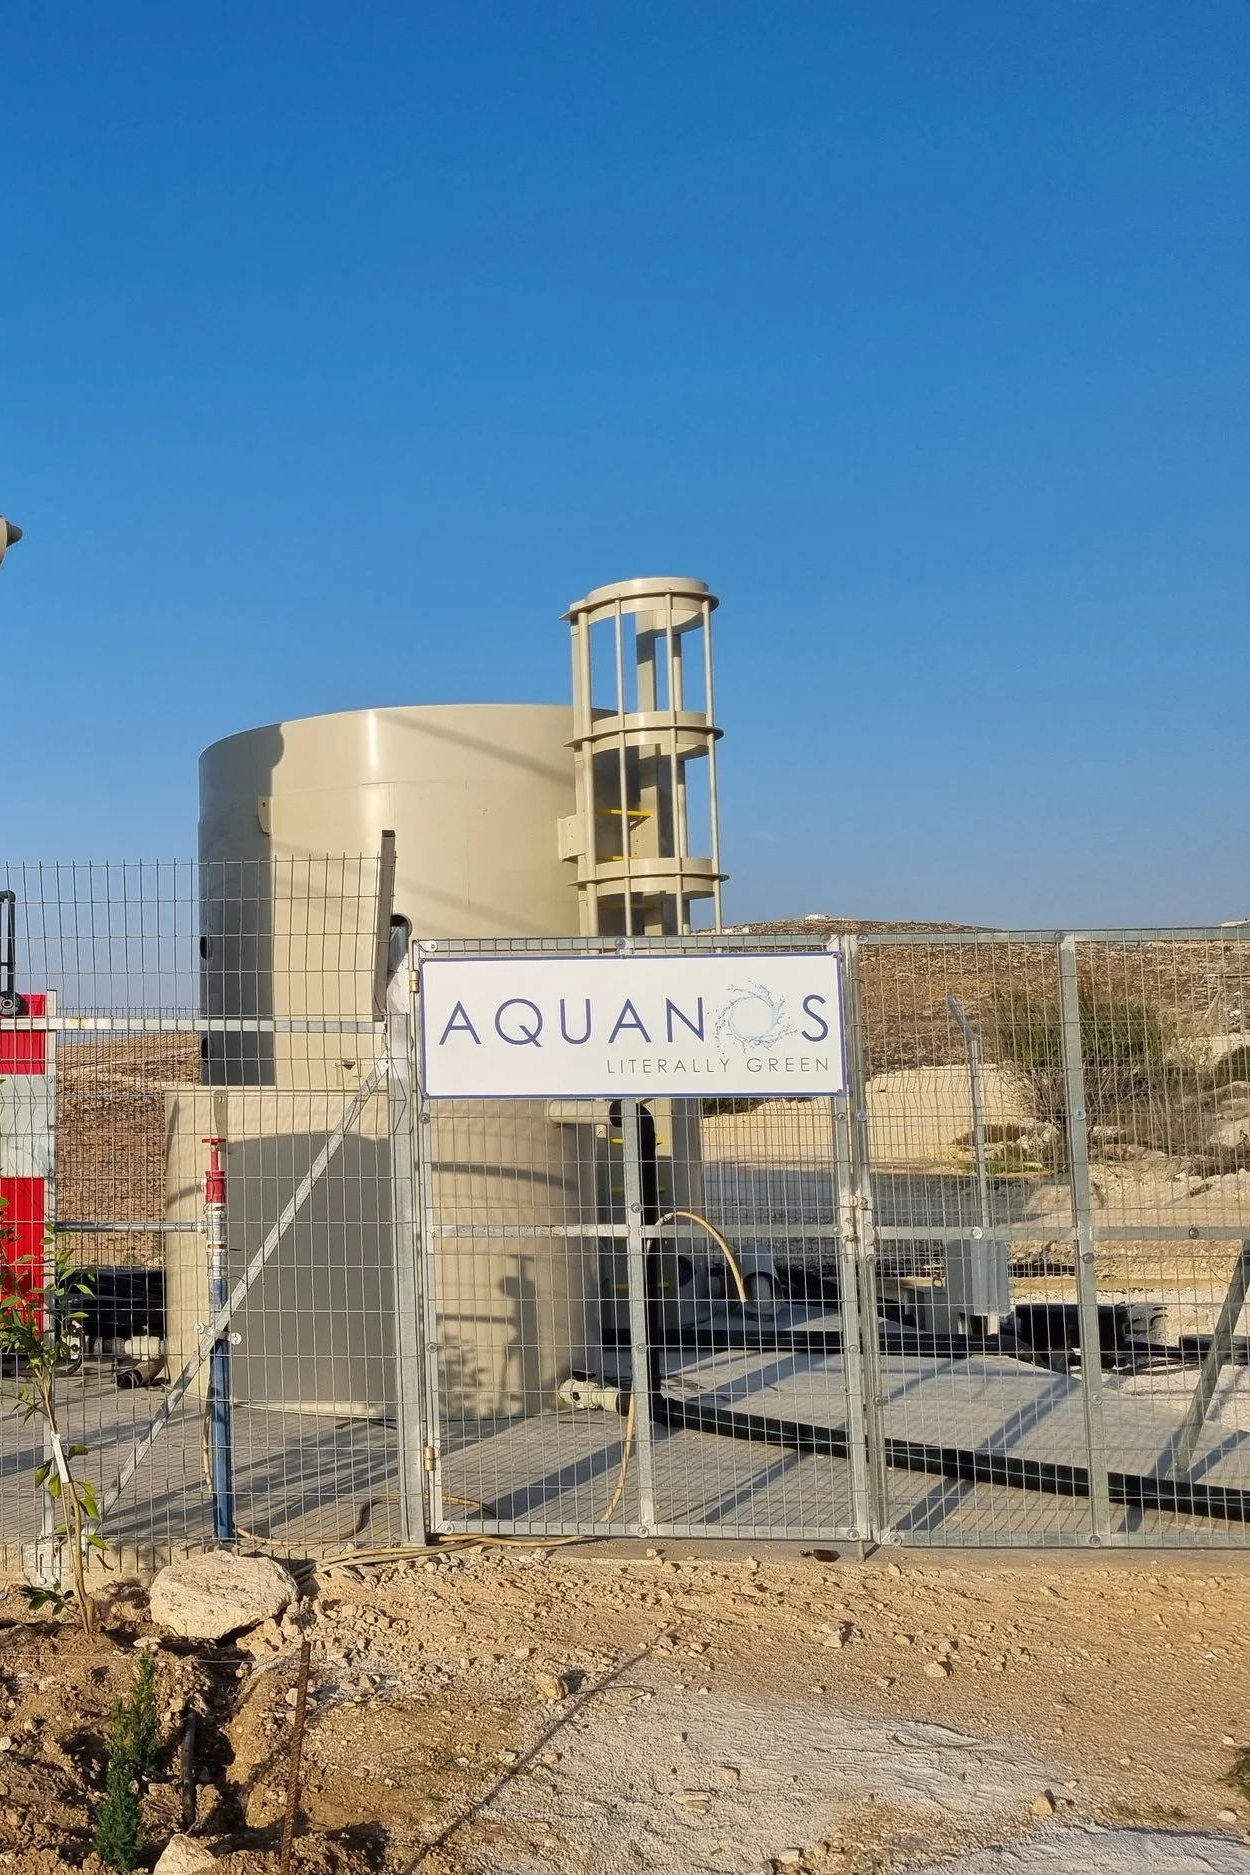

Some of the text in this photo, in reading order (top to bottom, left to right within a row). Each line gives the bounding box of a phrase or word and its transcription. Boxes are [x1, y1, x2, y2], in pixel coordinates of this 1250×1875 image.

[438, 992, 830, 1049] AQUANOS
[606, 1056, 830, 1075] LITERALLY GREEN
